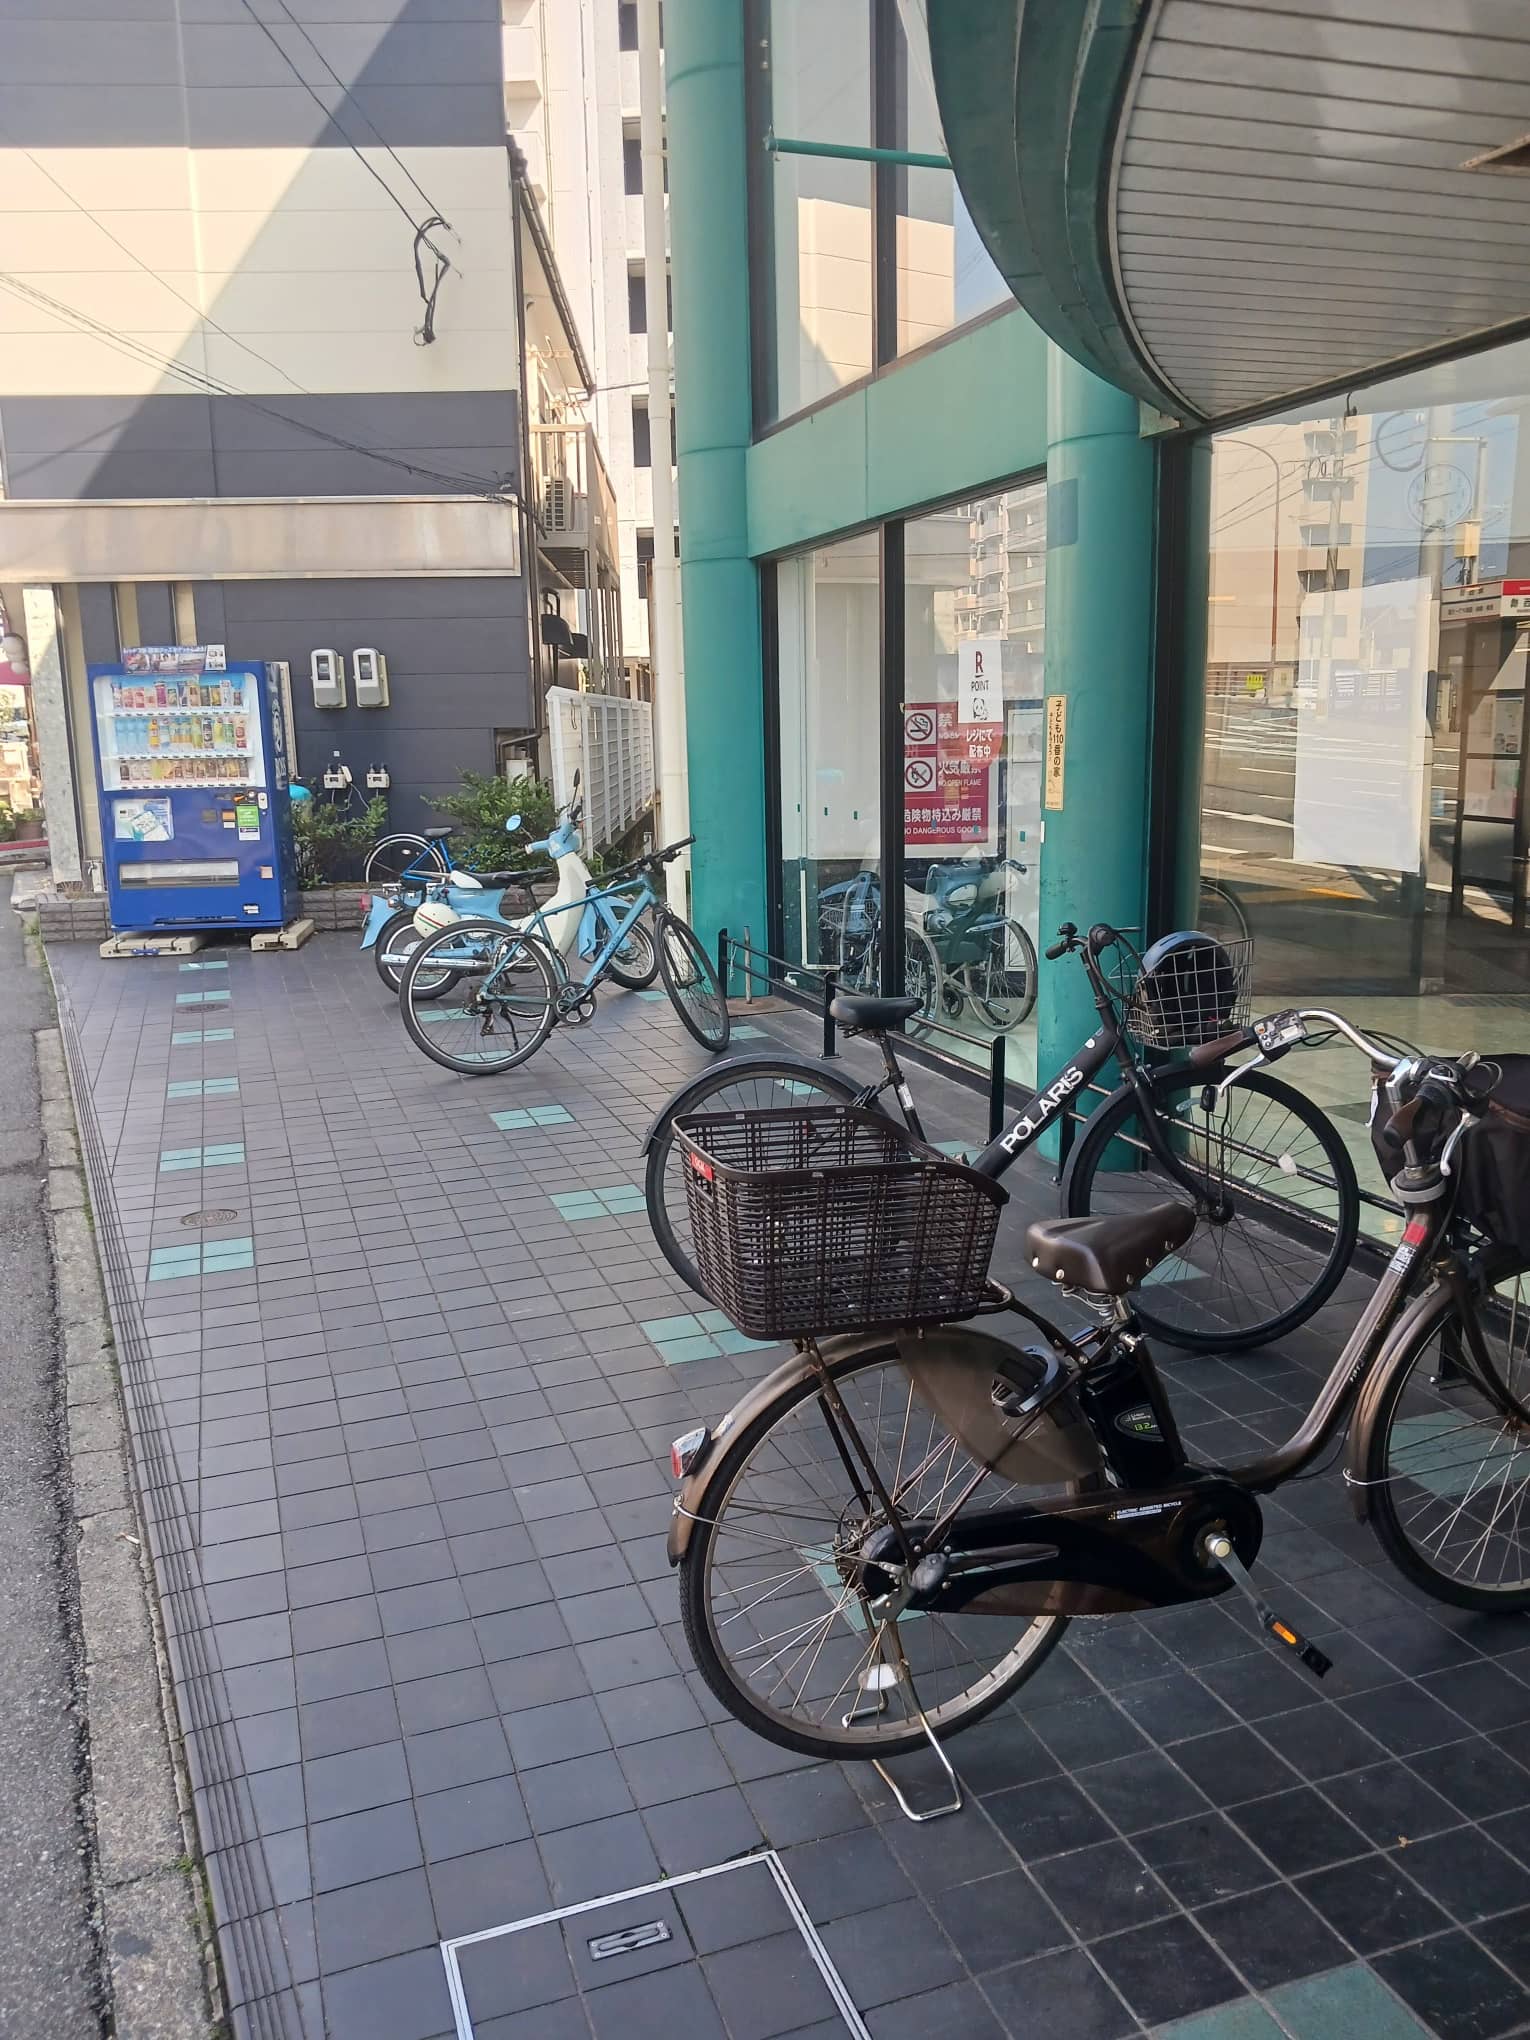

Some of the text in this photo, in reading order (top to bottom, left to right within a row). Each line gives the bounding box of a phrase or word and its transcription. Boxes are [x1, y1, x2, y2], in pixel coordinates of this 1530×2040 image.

[975, 650, 984, 674] R
[970, 679, 990, 692] POINT
[965, 728, 994, 742] レジにて
[968, 744, 991, 759] 配布中
[963, 778, 982, 786] FLAME
[912, 825, 956, 835] DANGEROUS
[999, 1065, 1084, 1154] POLARIS
